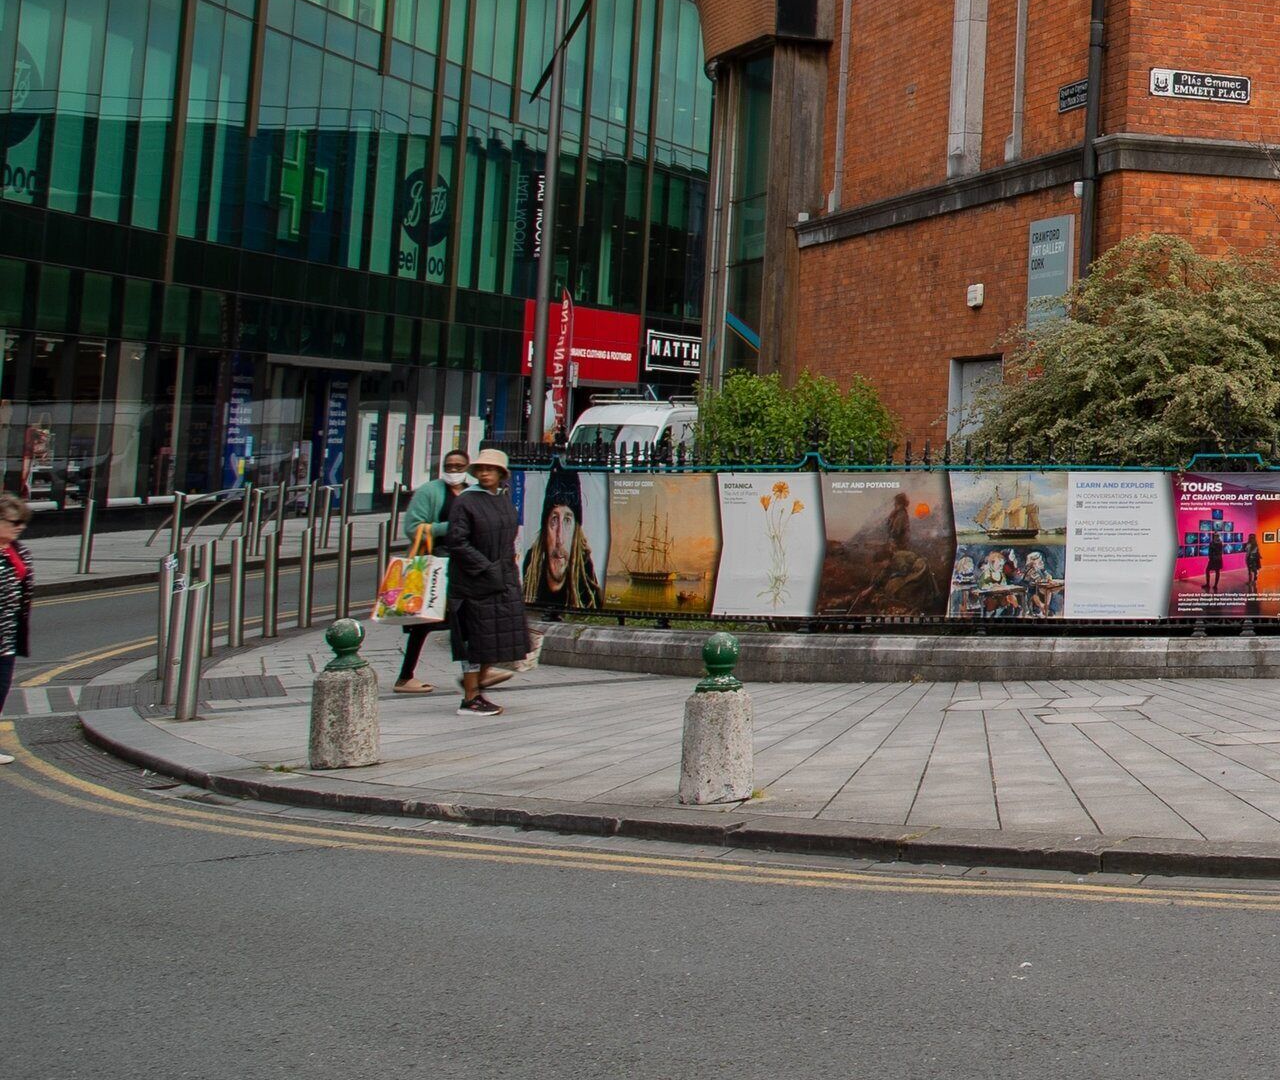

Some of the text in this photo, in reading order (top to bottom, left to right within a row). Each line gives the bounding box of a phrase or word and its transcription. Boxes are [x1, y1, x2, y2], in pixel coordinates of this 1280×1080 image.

[1174, 84, 1247, 99] EMMETT PLACE
[1032, 229, 1060, 244] CRAWFORD
[1031, 241, 1066, 257] ART GALLERY
[1031, 258, 1045, 271] CORK
[651, 338, 700, 360] MATTH
[613, 488, 640, 496] COLLECTION
[724, 482, 753, 490] BOTANICA
[1182, 482, 1223, 492] TOURS
